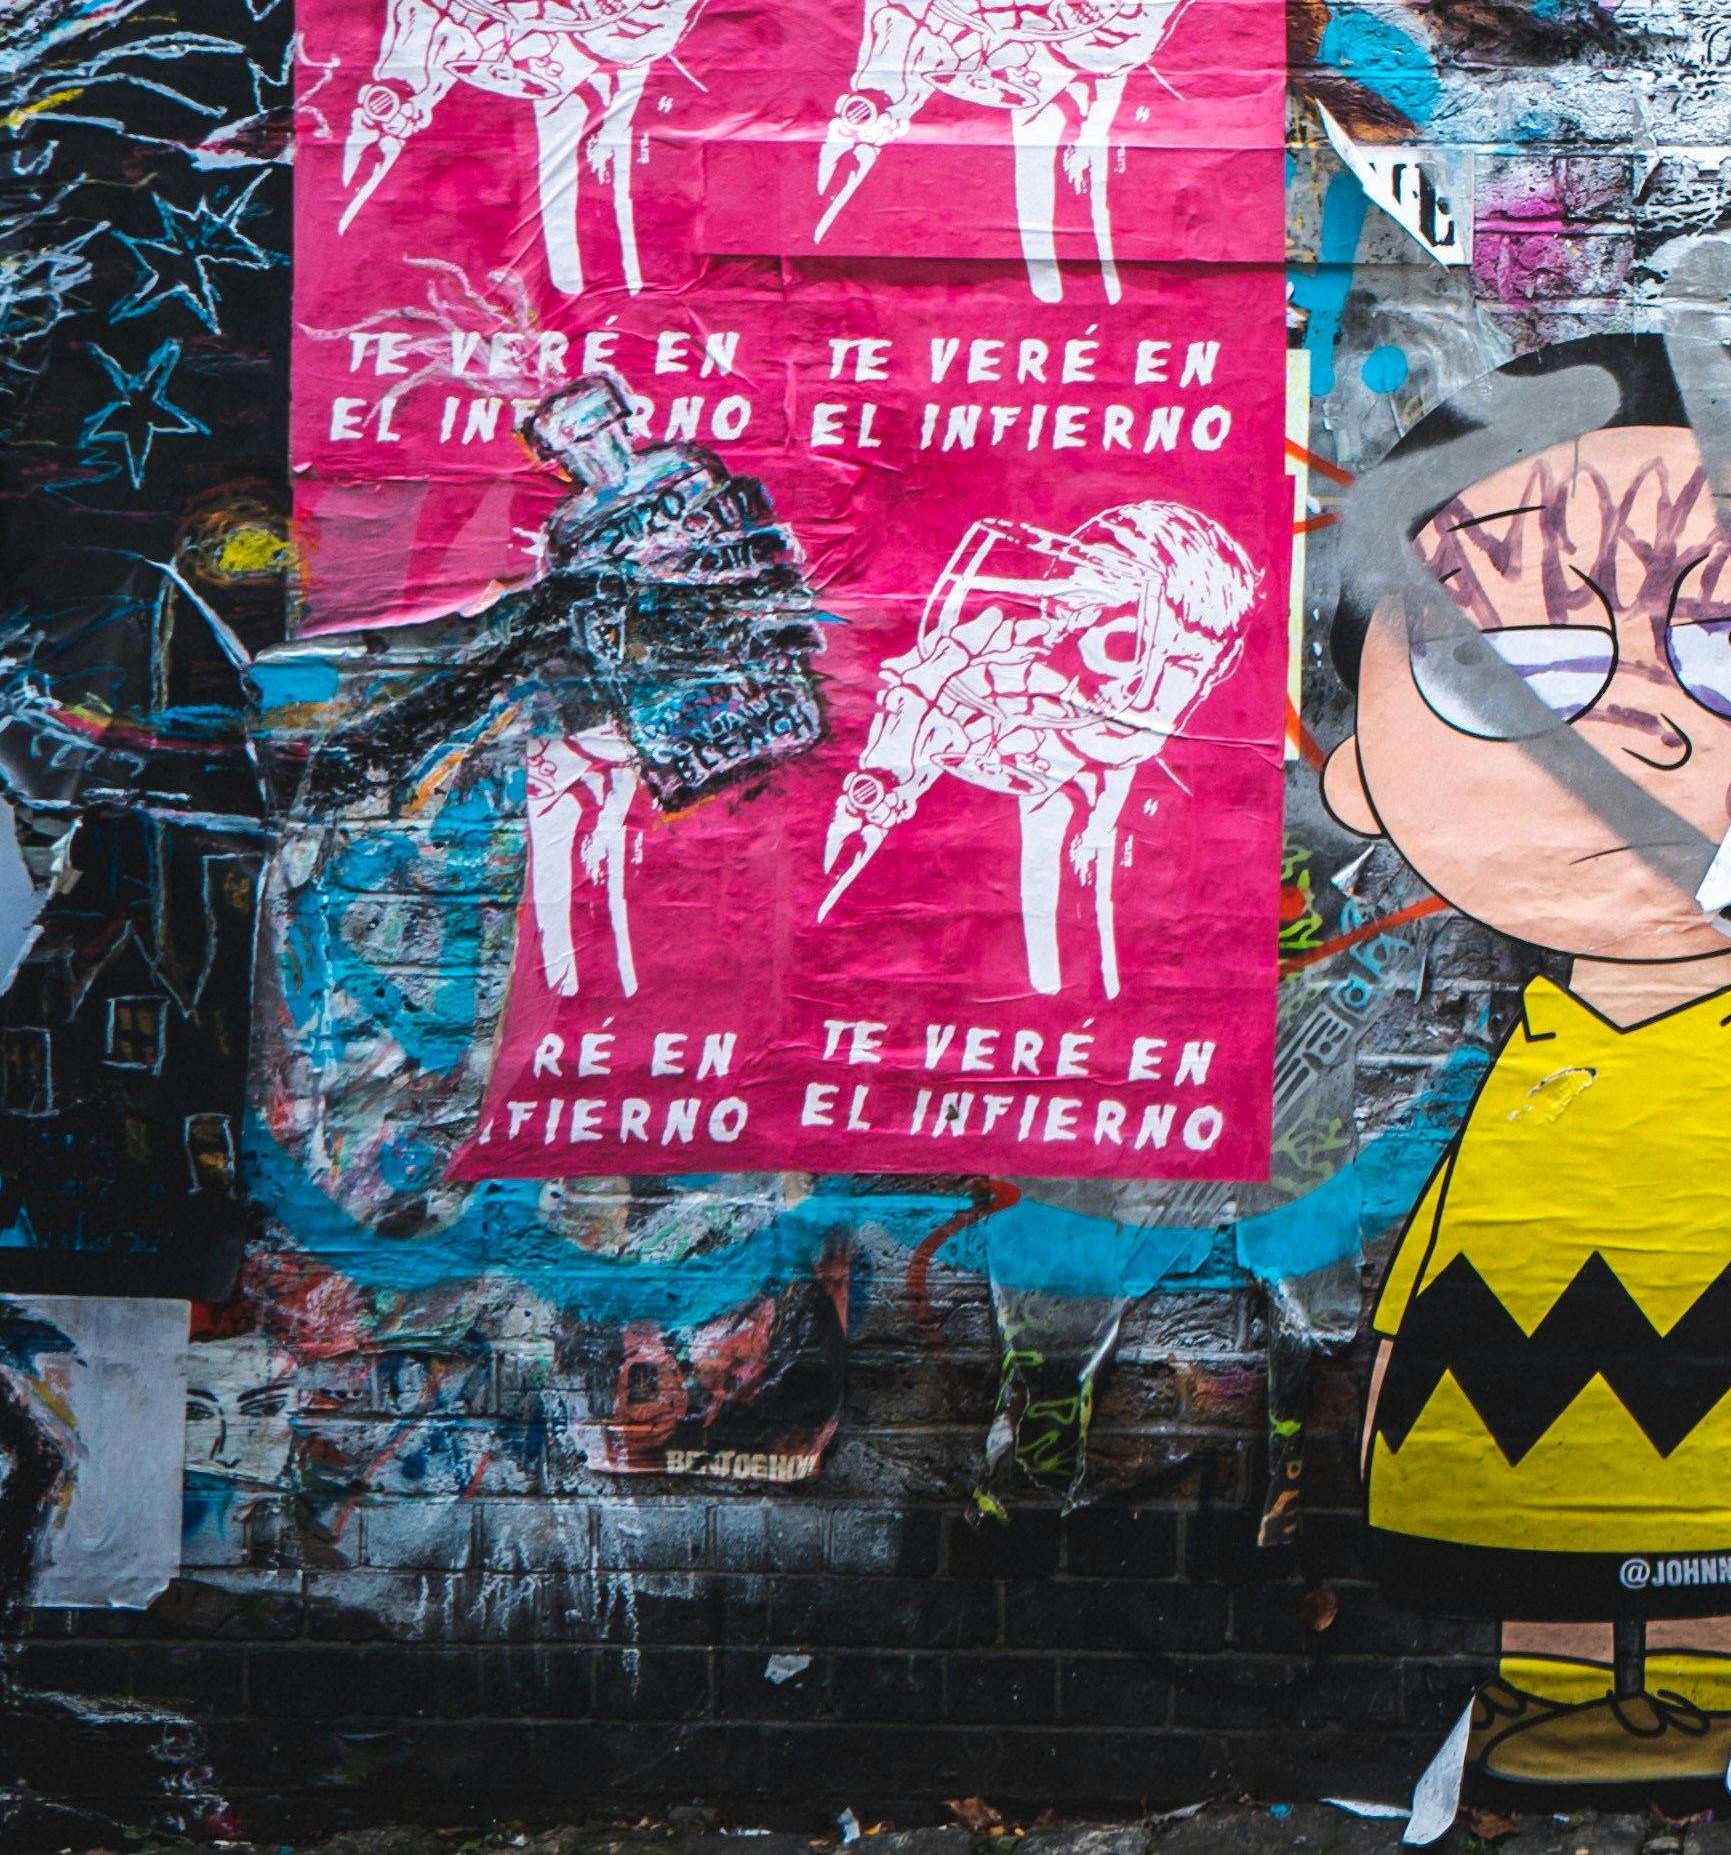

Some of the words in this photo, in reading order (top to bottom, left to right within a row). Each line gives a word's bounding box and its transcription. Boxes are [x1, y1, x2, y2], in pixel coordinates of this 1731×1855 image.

[347, 332, 410, 377] TE
[451, 313, 619, 380] VERÉ
[654, 330, 738, 380] EN
[829, 337, 890, 383] TE
[929, 323, 1100, 384] VERÉ
[1134, 339, 1221, 389] EN
[330, 397, 401, 442] EL
[440, 393, 753, 446] INFRNO
[811, 403, 883, 448] EL
[921, 402, 1232, 454] INFIERNO
[651, 1030, 738, 1081] EN
[822, 1019, 889, 1065] TE
[924, 1017, 1095, 1078] VERÉ
[1128, 1036, 1218, 1086] EN
[480, 1096, 749, 1146] FIERNO
[800, 1082, 874, 1131] EL
[911, 1090, 1223, 1151] INFIERNO
